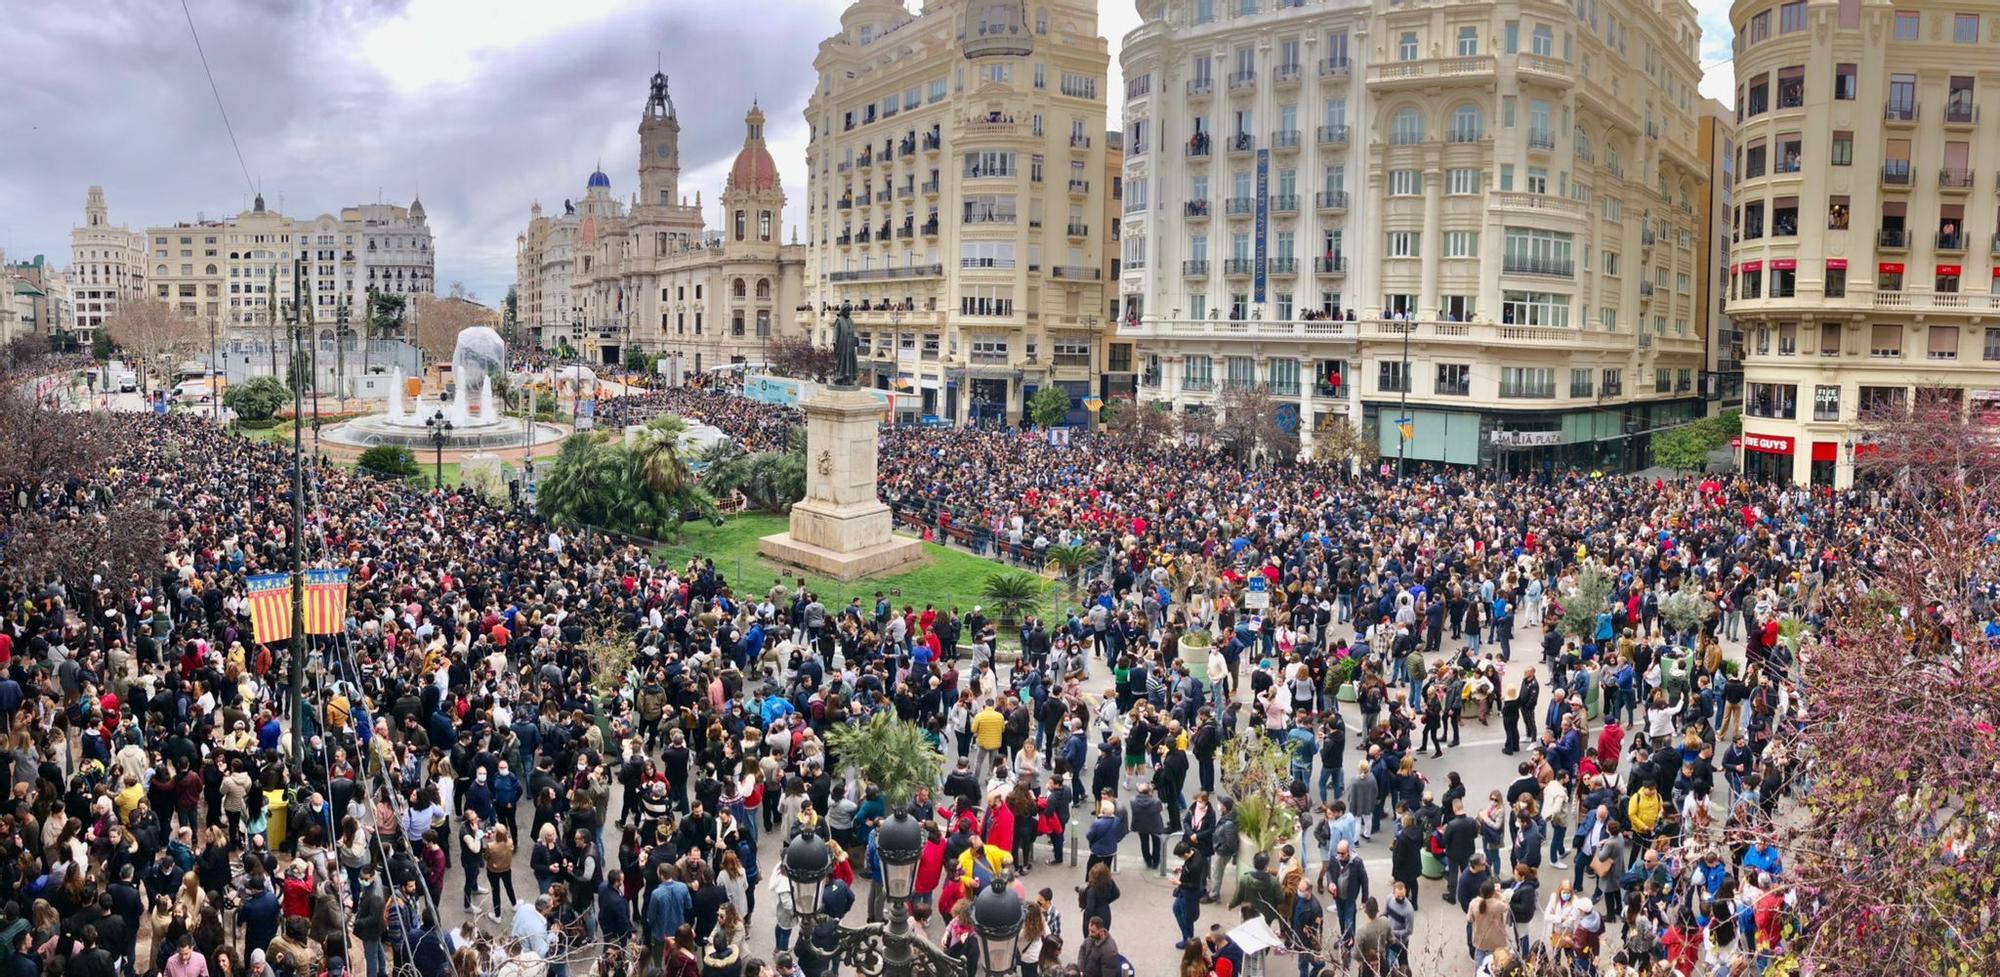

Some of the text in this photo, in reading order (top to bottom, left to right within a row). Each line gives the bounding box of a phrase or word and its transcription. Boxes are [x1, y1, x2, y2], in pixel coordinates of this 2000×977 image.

[1258, 172, 1266, 206] CENTRO
[1536, 435, 1561, 444] PLAZA
[1760, 438, 1788, 450] GUYS
